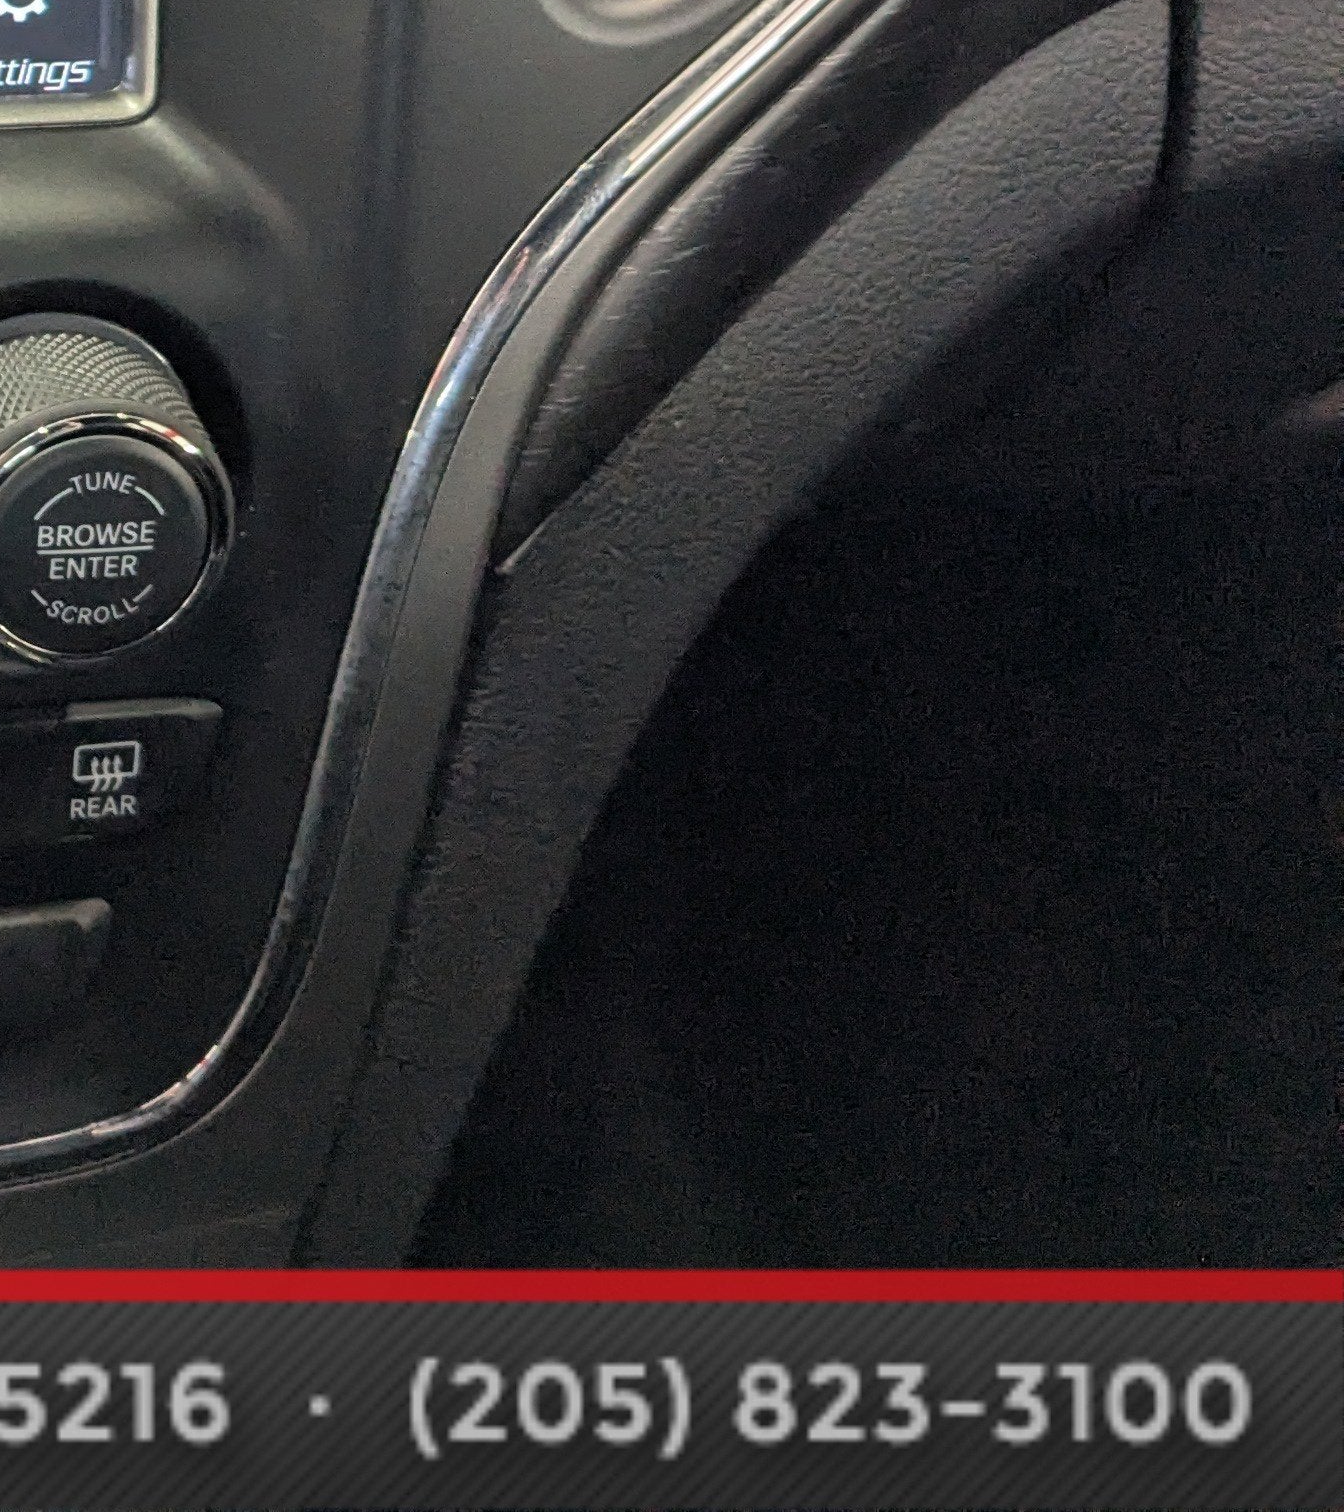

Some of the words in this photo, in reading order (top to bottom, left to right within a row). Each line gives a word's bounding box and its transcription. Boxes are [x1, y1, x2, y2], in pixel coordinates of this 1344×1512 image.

[68, 470, 137, 496] TUNE
[35, 519, 156, 550] BROWSE
[47, 553, 140, 582] ENTER
[45, 593, 139, 627] SCROLL
[69, 793, 138, 820] REAR
